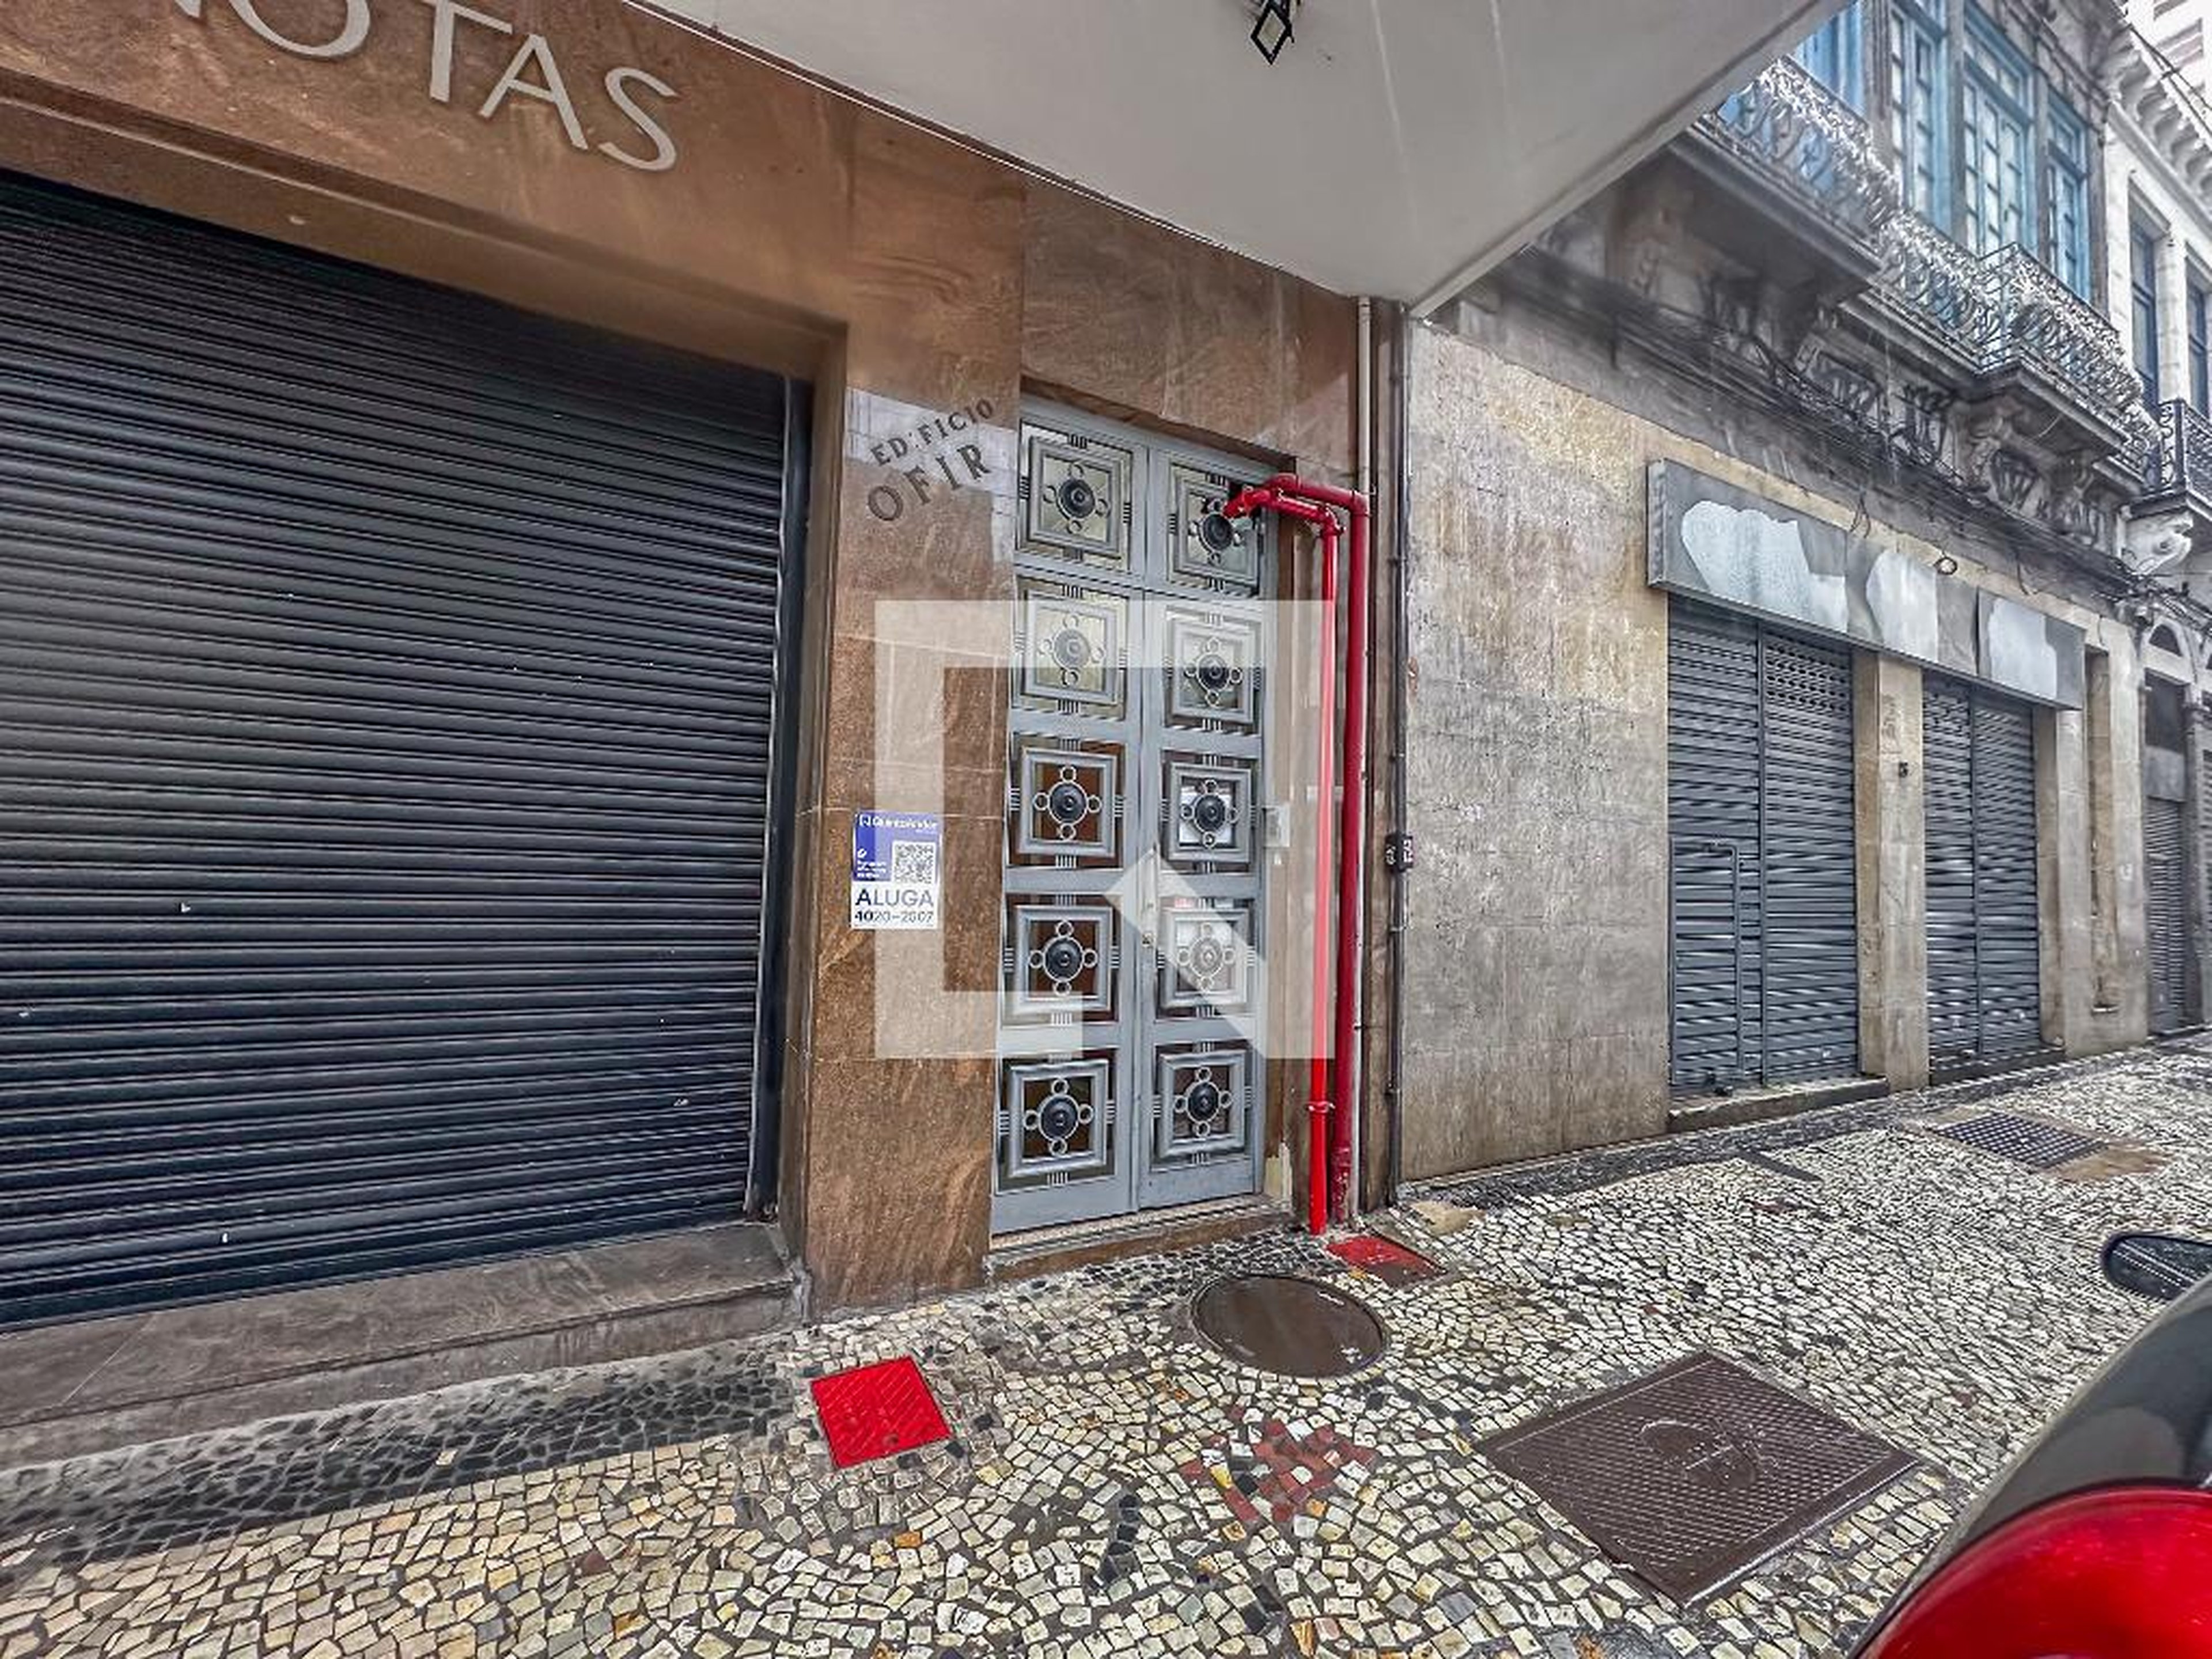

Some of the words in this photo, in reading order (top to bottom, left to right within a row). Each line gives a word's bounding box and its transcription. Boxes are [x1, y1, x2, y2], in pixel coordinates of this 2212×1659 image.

[173, 0, 679, 173] OTAS
[870, 399, 994, 467] EDFICIO
[868, 444, 991, 521] OFIR
[855, 888, 934, 907] ALUGA
